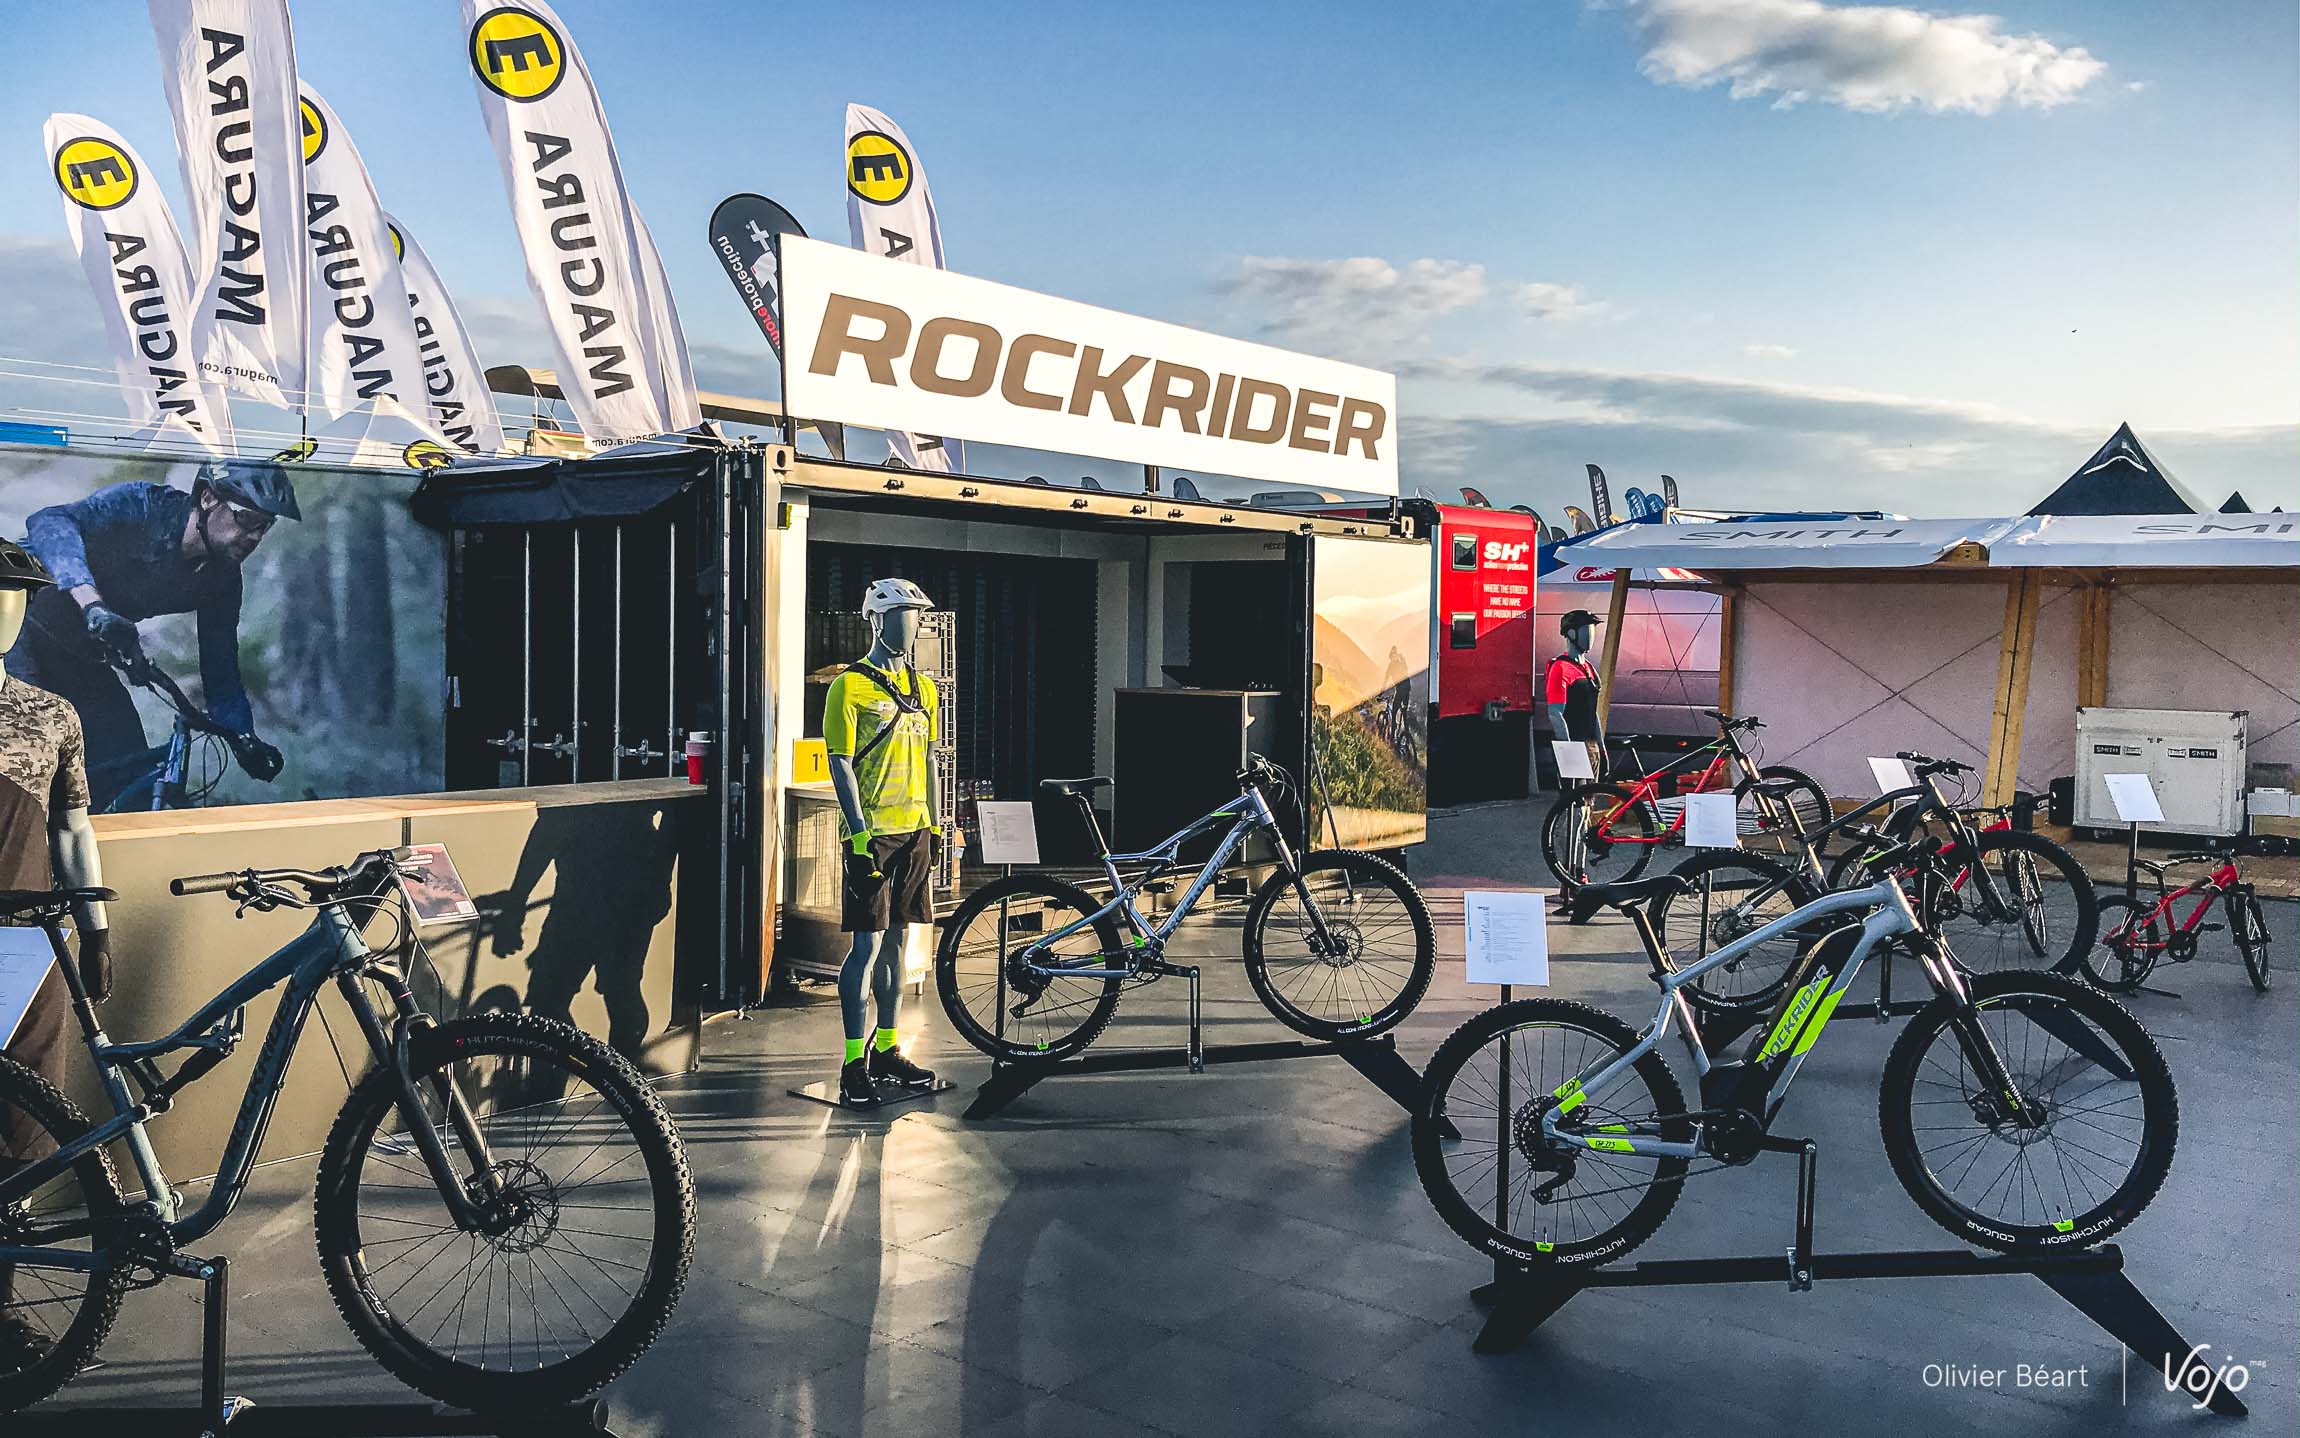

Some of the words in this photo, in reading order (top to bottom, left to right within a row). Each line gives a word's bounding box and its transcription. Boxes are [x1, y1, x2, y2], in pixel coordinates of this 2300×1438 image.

[808, 292, 1387, 461] ROCKRIDER
[1677, 527, 1905, 543] SMITH
[1760, 964, 1829, 1072] ROCKRIDER
[1966, 1219, 2016, 1243] COUGAR
[2040, 1215, 2114, 1245] HUTCHINSON
[1487, 1237, 1533, 1262] COUGAR
[1556, 1236, 1627, 1264] HUTCHINSON
